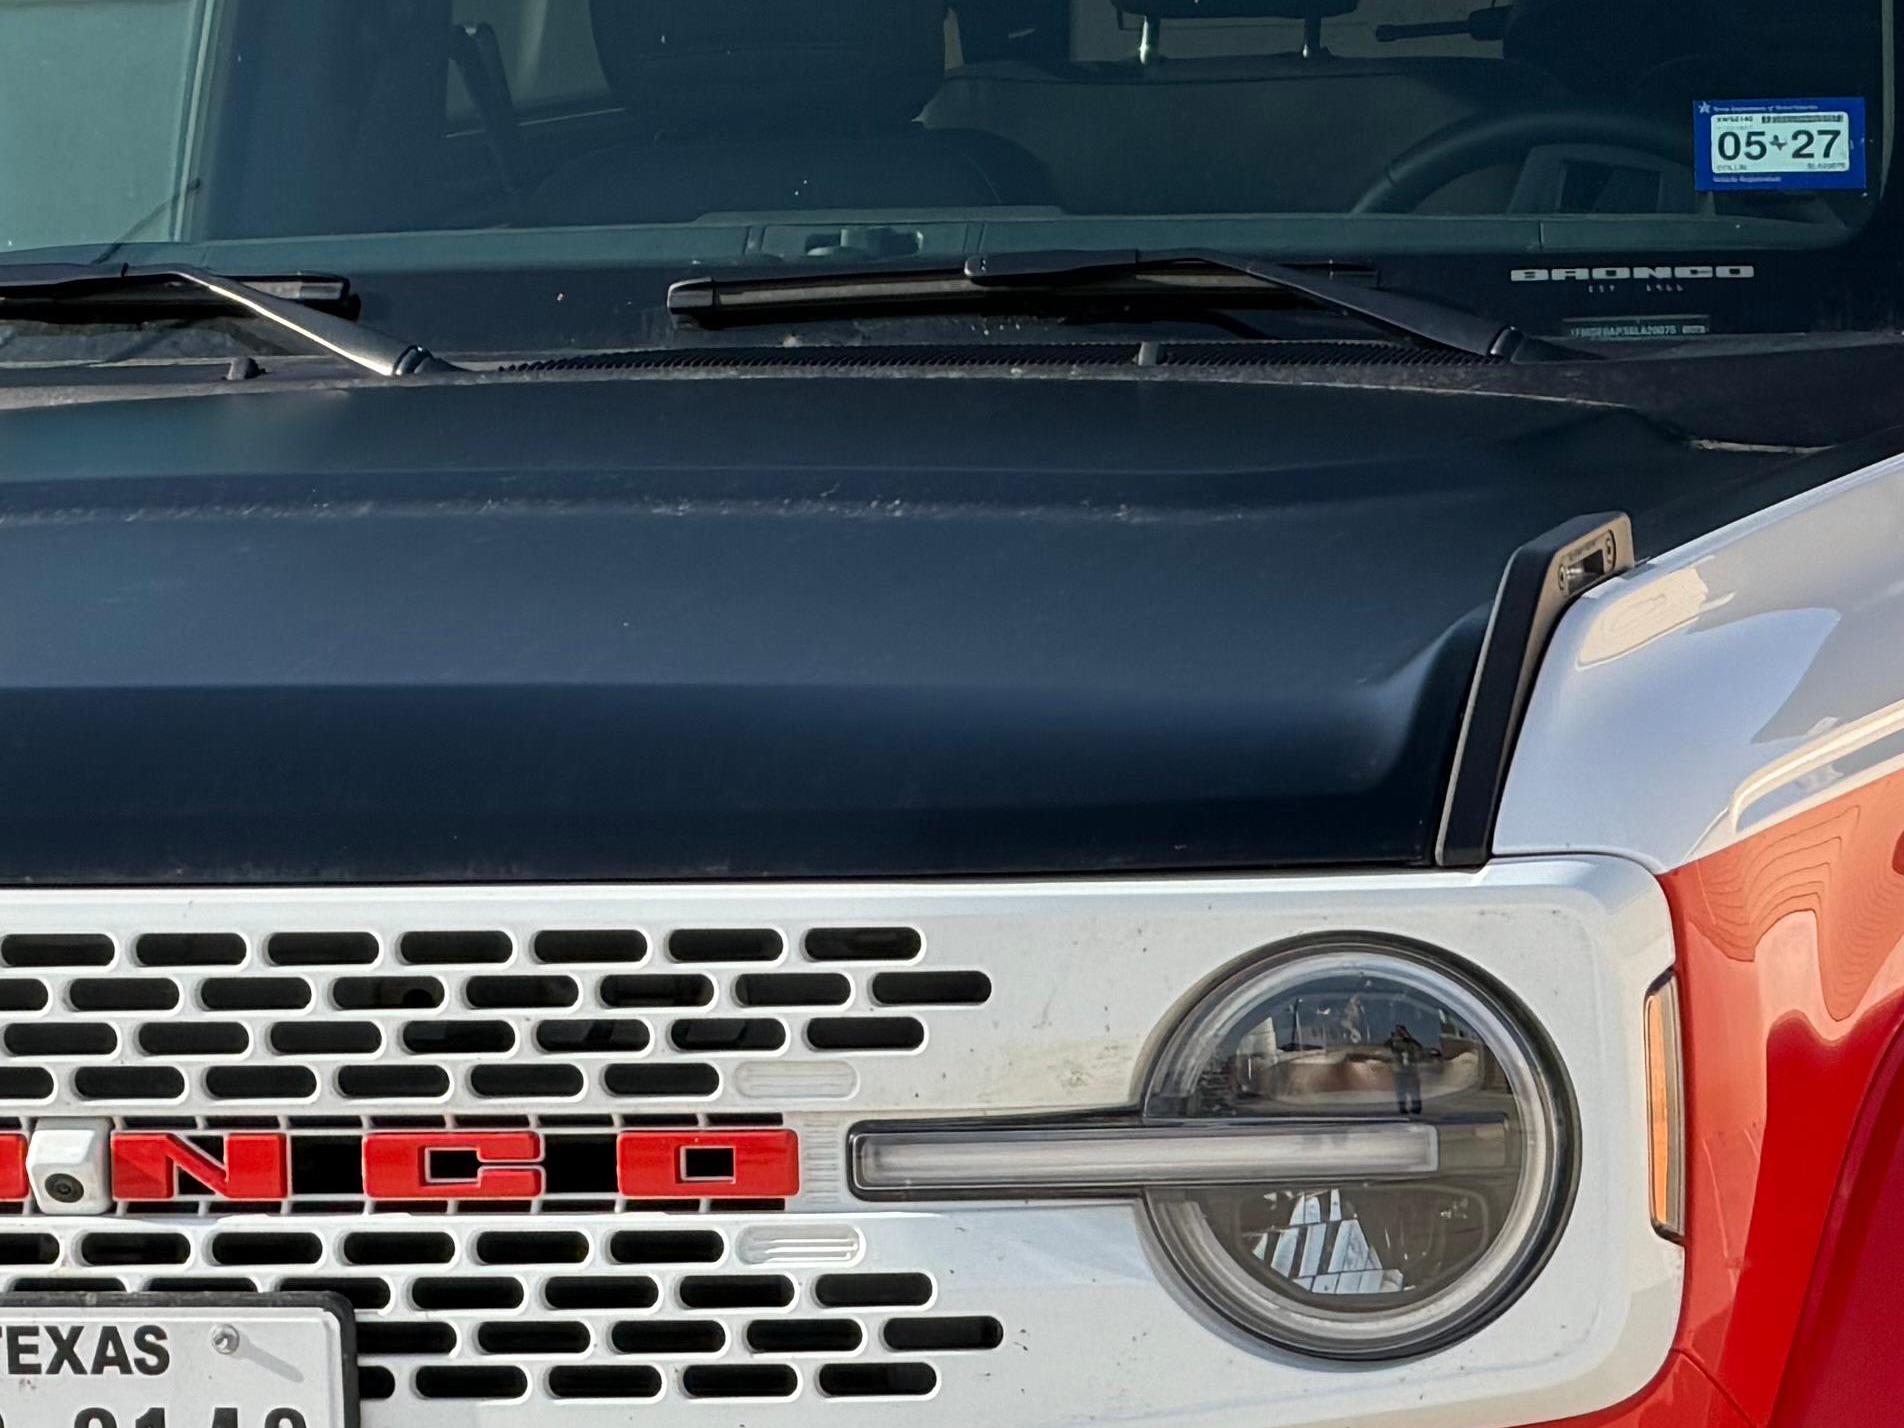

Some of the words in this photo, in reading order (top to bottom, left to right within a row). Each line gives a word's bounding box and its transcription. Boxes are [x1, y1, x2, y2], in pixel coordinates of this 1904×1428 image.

[1718, 131, 1768, 161] 05
[1791, 129, 1841, 159] 27
[1510, 266, 1755, 282] BRONCO
